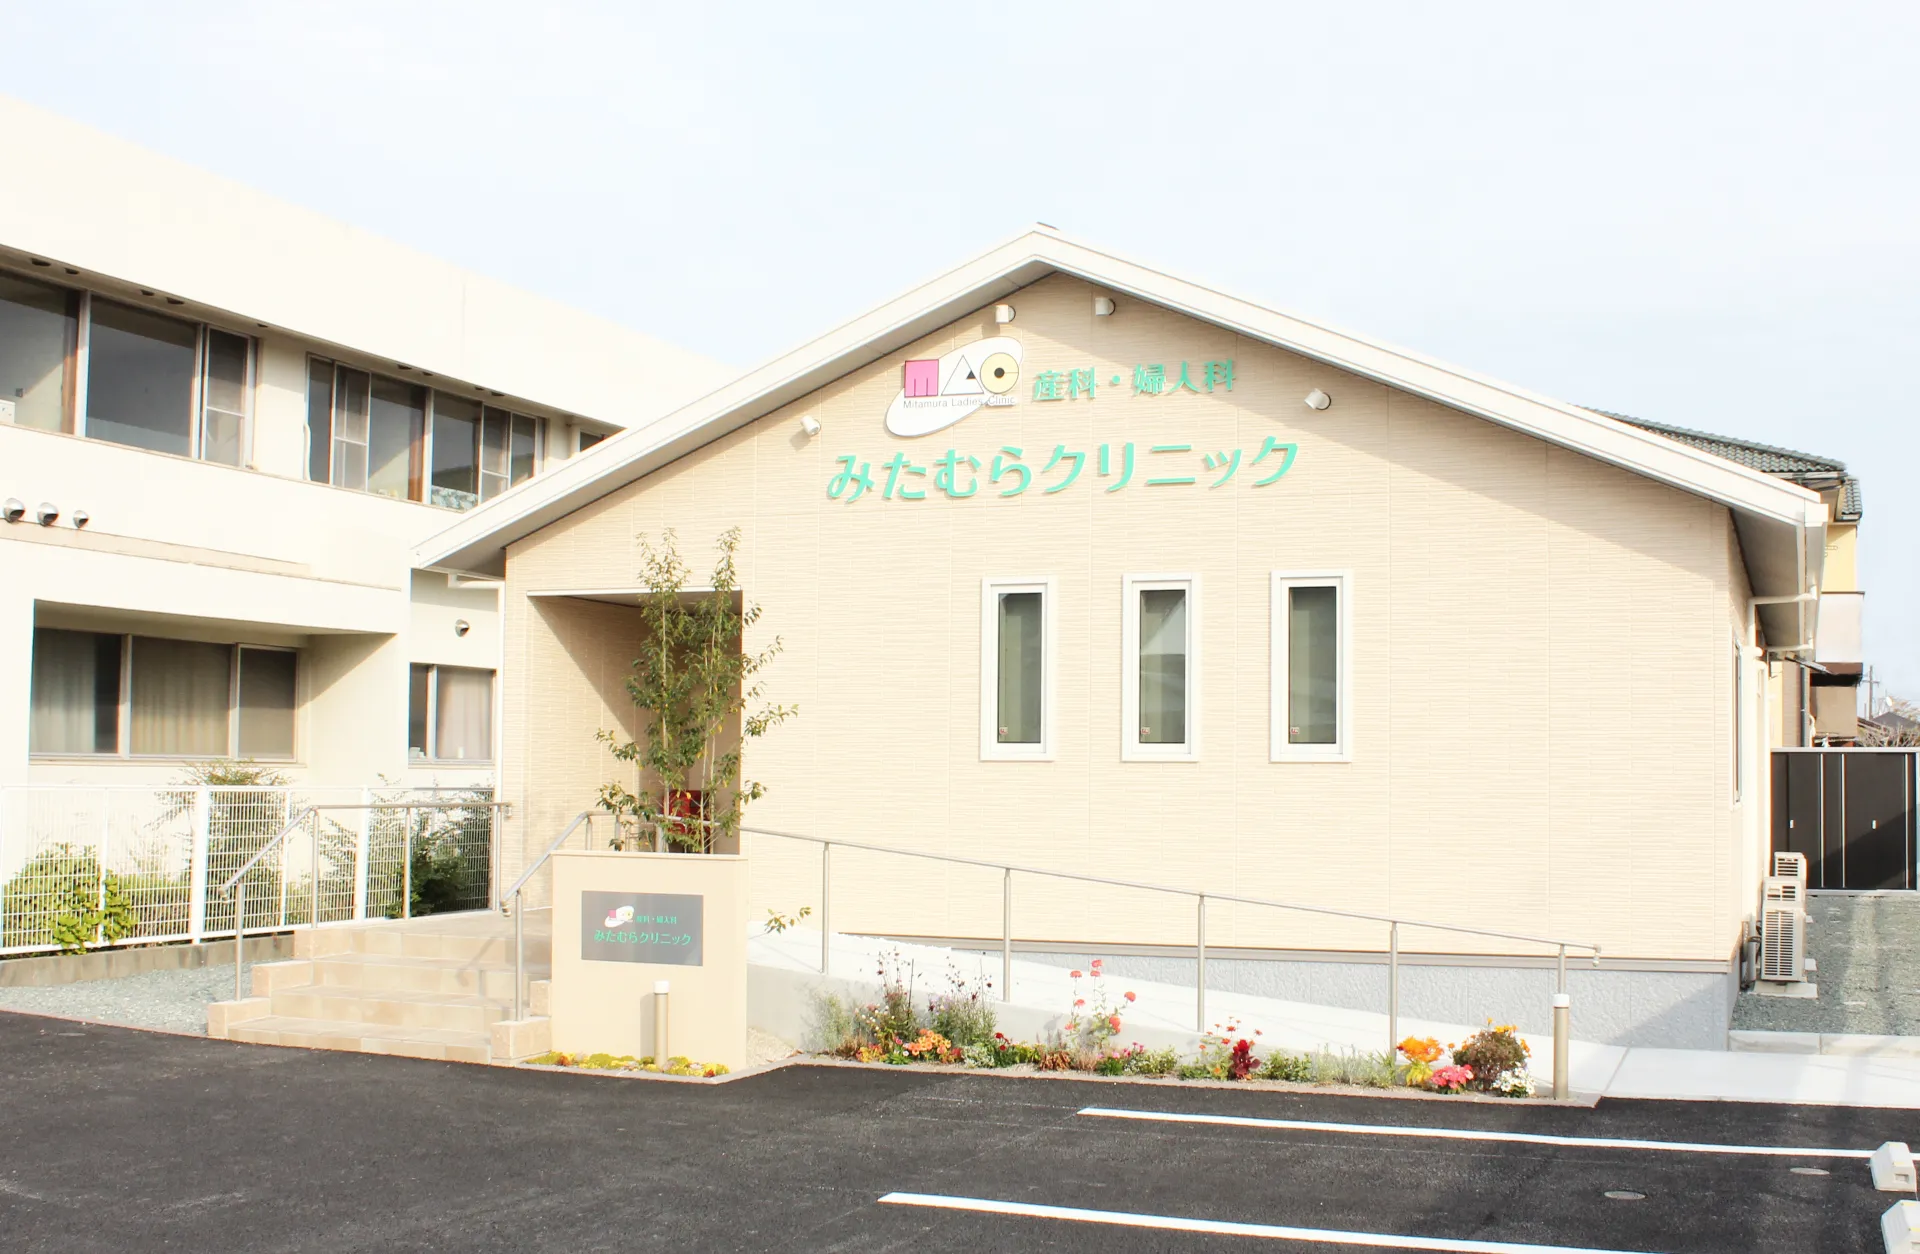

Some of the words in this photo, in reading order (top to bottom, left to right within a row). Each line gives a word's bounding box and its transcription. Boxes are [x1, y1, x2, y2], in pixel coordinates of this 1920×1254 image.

[1033, 358, 1236, 401] 産科・婦人科
[903, 400, 948, 409] Mitamura
[951, 397, 984, 407] Ladies
[988, 395, 1015, 405] Clinic
[827, 435, 1299, 503] みたむらクリニック
[594, 930, 692, 945] みたむらクリニック
